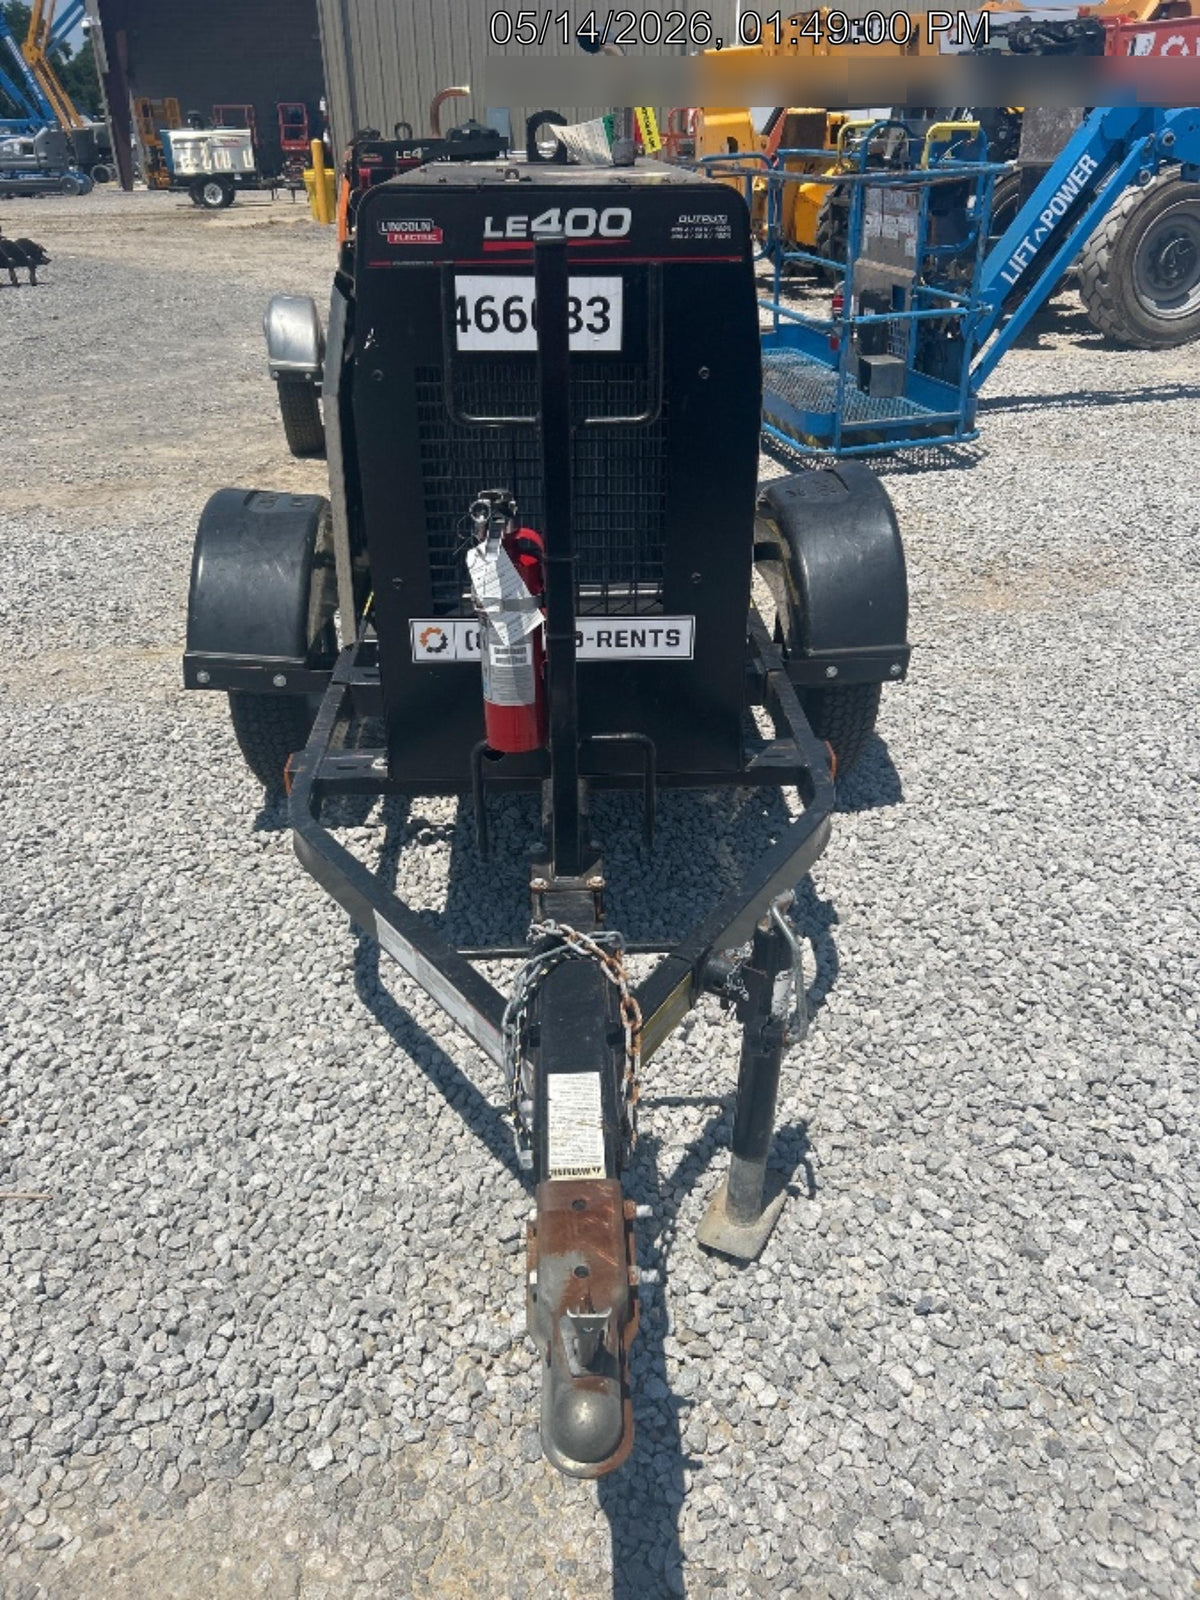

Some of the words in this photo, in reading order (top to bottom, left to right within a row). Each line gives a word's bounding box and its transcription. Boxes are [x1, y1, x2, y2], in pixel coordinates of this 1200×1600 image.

[381, 221, 431, 232] LINCOLN
[483, 207, 632, 238] LE400
[1000, 236, 1038, 286] LIFT
[1040, 153, 1099, 231] POWER
[394, 233, 438, 241] ELECTRIC
[455, 294, 611, 334] 46683
